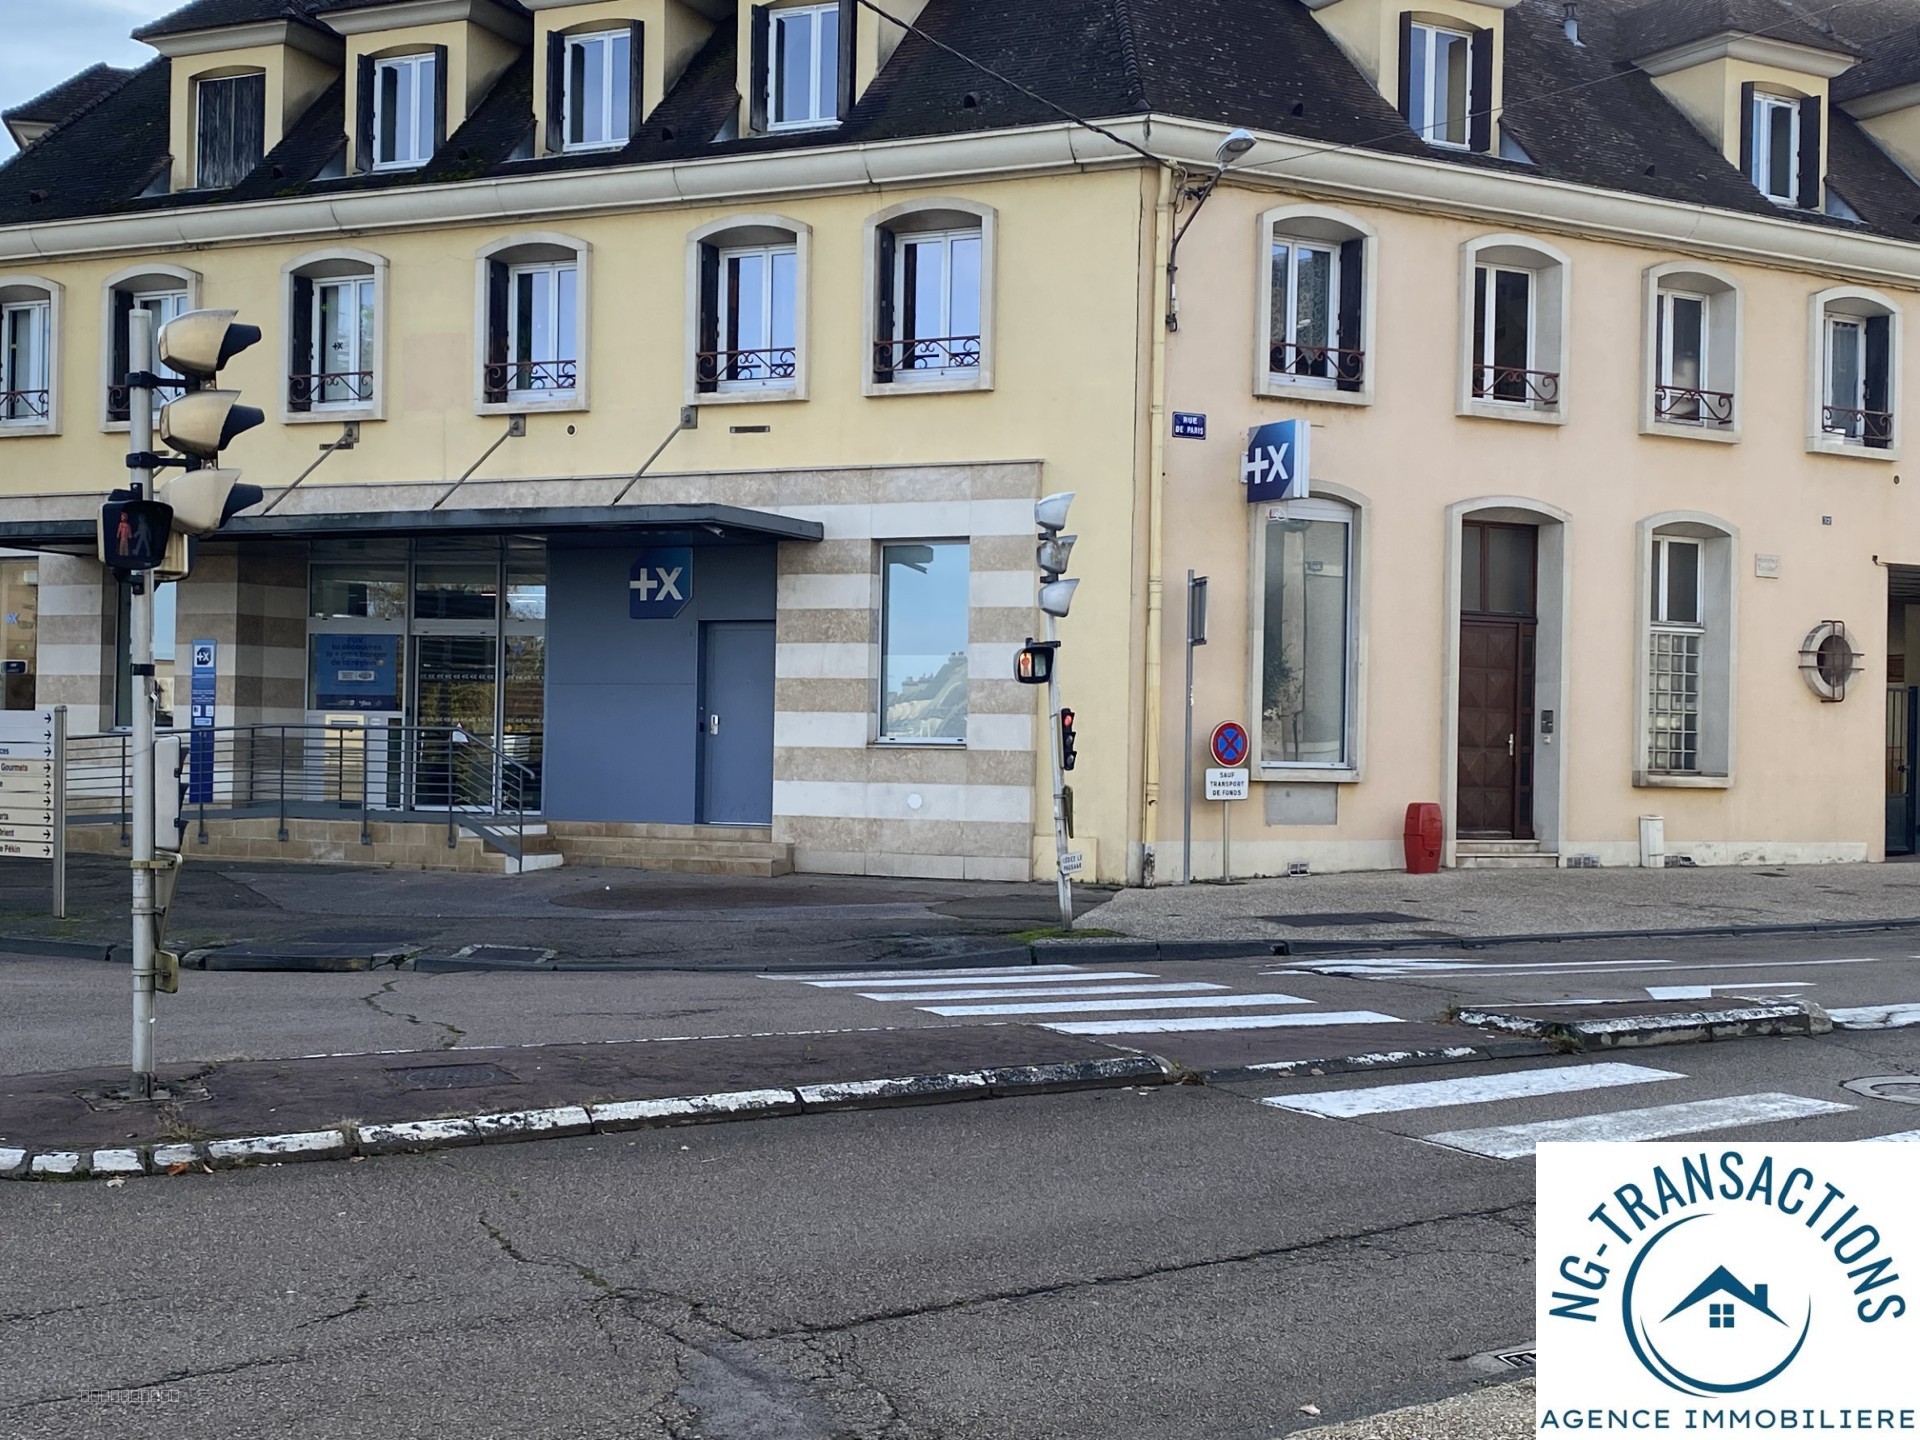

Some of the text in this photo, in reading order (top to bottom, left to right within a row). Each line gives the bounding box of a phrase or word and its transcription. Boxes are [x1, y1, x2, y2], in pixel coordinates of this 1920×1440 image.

[1183, 416, 1198, 424] RUE
[1175, 425, 1204, 435] DE PARIS
[629, 567, 684, 601] +X
[196, 652, 210, 662] +X
[1, 763, 28, 771] Gourmets
